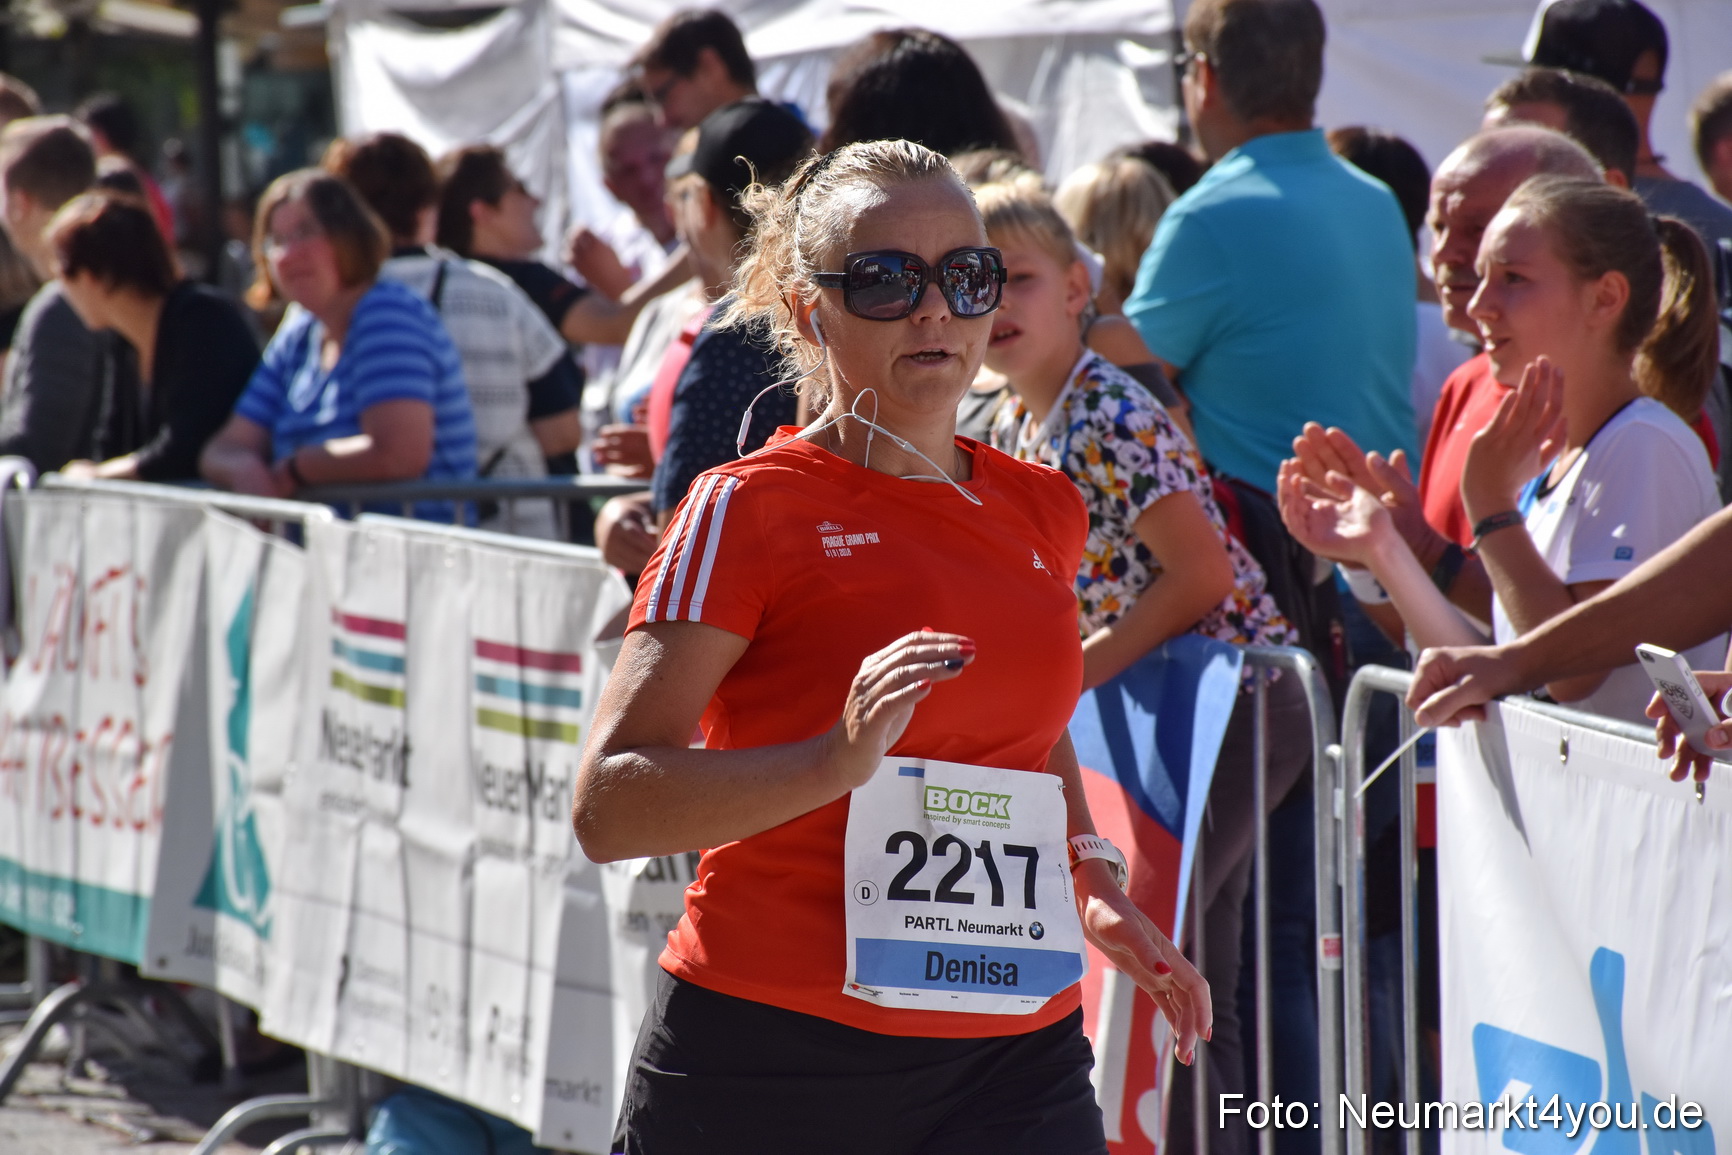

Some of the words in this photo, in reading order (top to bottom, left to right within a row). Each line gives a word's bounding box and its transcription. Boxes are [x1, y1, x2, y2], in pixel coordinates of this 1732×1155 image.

[822, 535, 846, 549] PRAGUE
[844, 533, 866, 546] GRAND
[864, 531, 881, 544] PRIX
[924, 786, 1012, 820] BOCK
[923, 811, 951, 823] inspired
[952, 815, 962, 826] by
[962, 818, 981, 826] smart
[981, 820, 1011, 830] concepts
[885, 830, 1040, 910] 2217
[904, 915, 954, 932] PARTL
[957, 919, 1024, 937] Neumarkt
[924, 950, 1019, 987] Denisa
